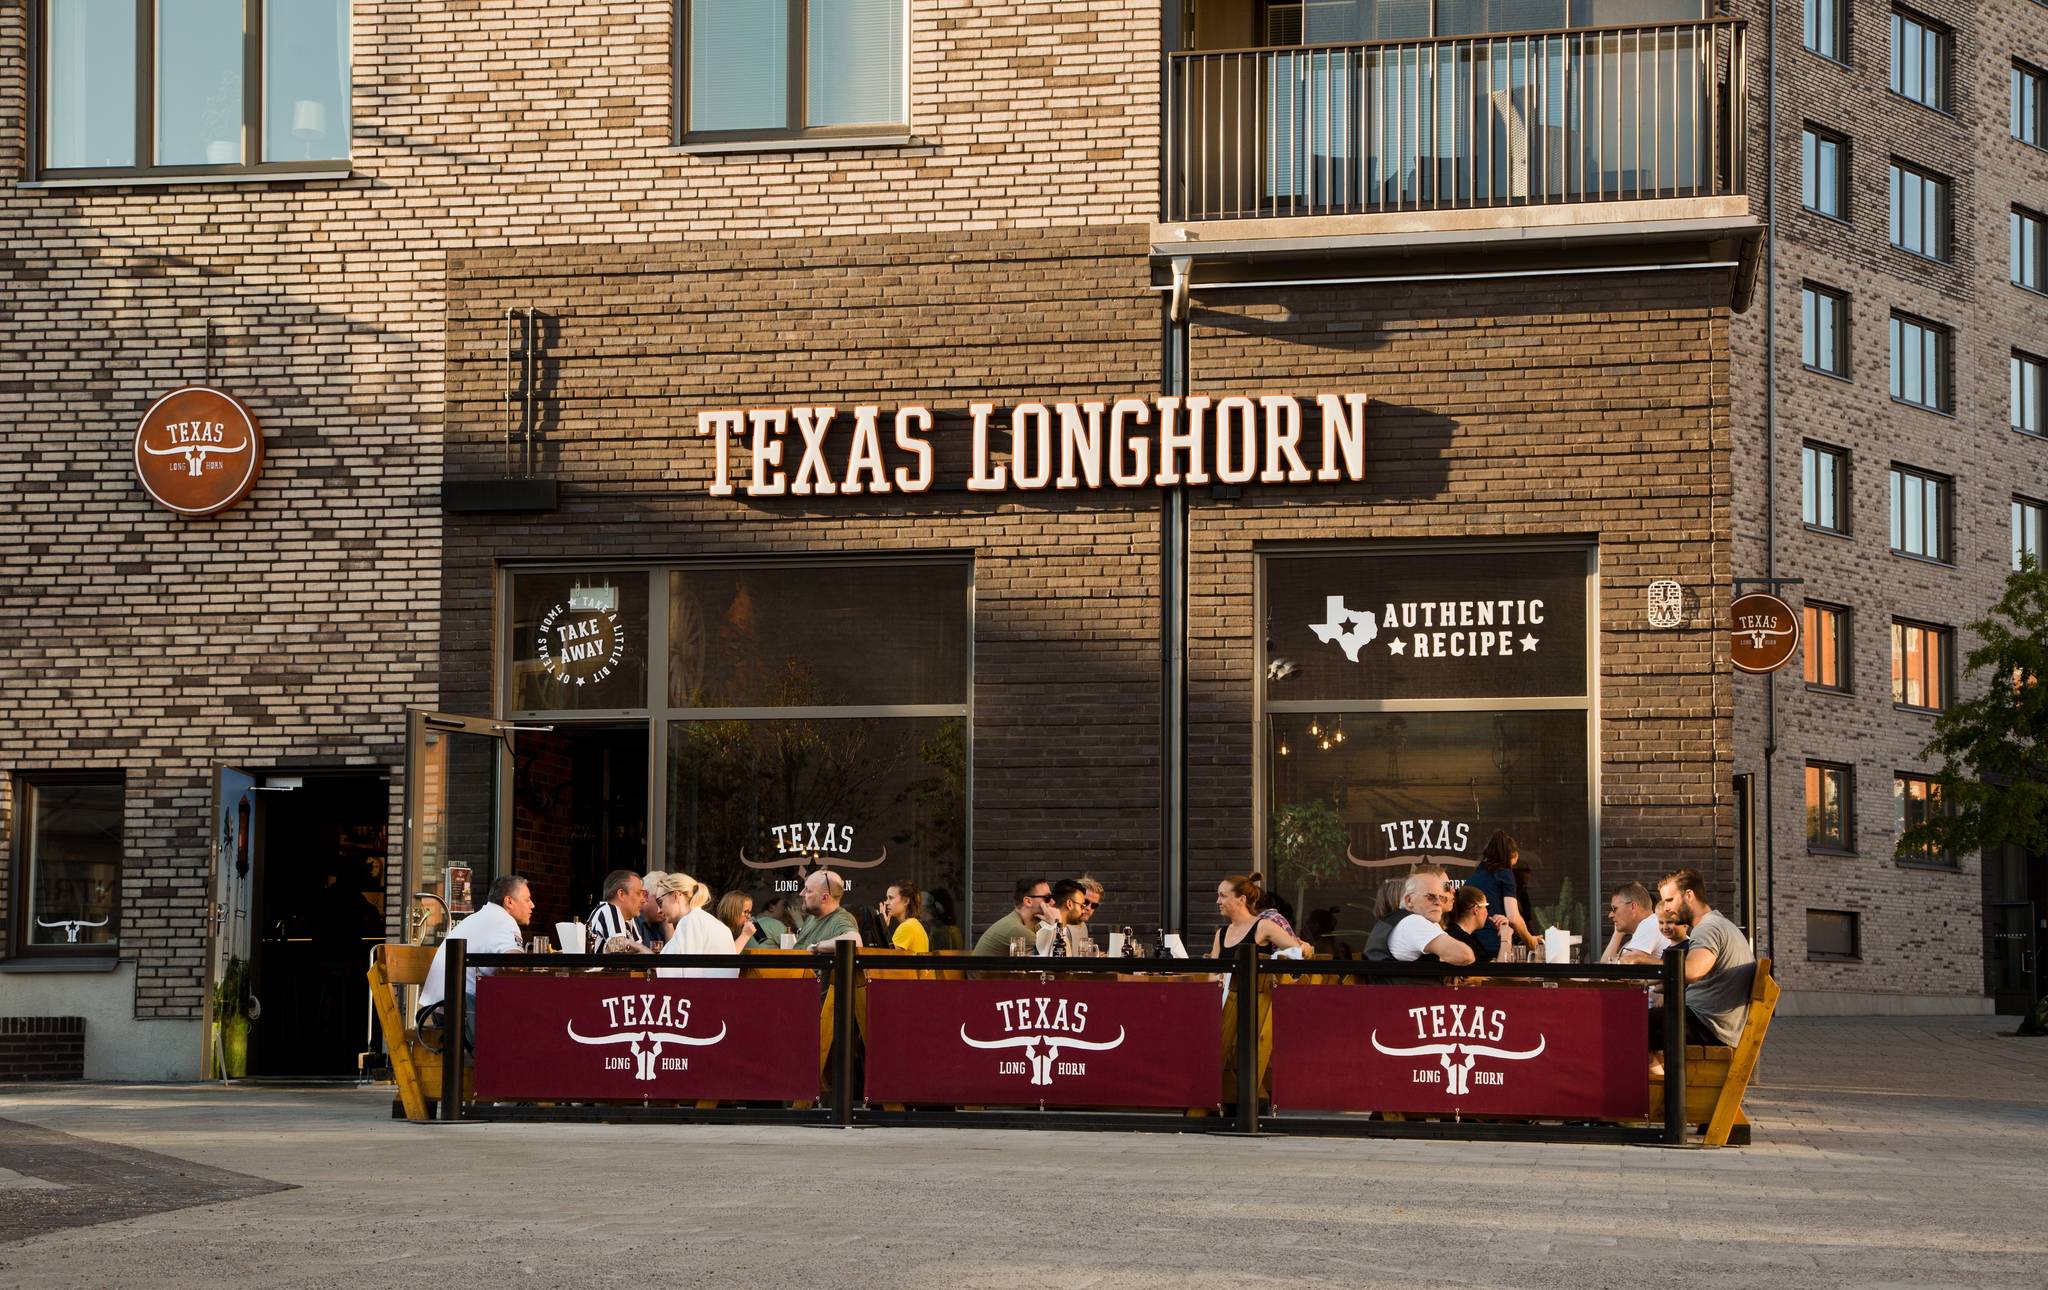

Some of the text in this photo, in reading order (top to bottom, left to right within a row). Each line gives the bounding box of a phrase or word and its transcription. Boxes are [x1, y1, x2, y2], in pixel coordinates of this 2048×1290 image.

[166, 421, 225, 444] TEXAS
[697, 392, 1368, 498] TEXAS LONGHORN
[169, 462, 187, 471] LONG
[1383, 599, 1544, 628] AUTHENTIC
[1739, 614, 1777, 629] TEXAS
[556, 618, 600, 642] TAKE
[582, 596, 624, 683] TAKE A LITTLE BIT
[537, 604, 570, 684] OF TEXAS HOME
[560, 639, 604, 664] AWAY
[1414, 631, 1513, 658] RECIPE
[771, 822, 854, 854] TEXAS
[1380, 819, 1470, 852] TEXAS
[775, 880, 798, 892] LONG
[602, 994, 692, 1029] TEXAS
[996, 997, 1088, 1033] TEXAS
[1408, 1004, 1507, 1042] TEXAS
[605, 1057, 688, 1071] LONG HORN
[999, 1061, 1086, 1076] LONG HORN
[1412, 1069, 1504, 1086] LONG HORN
